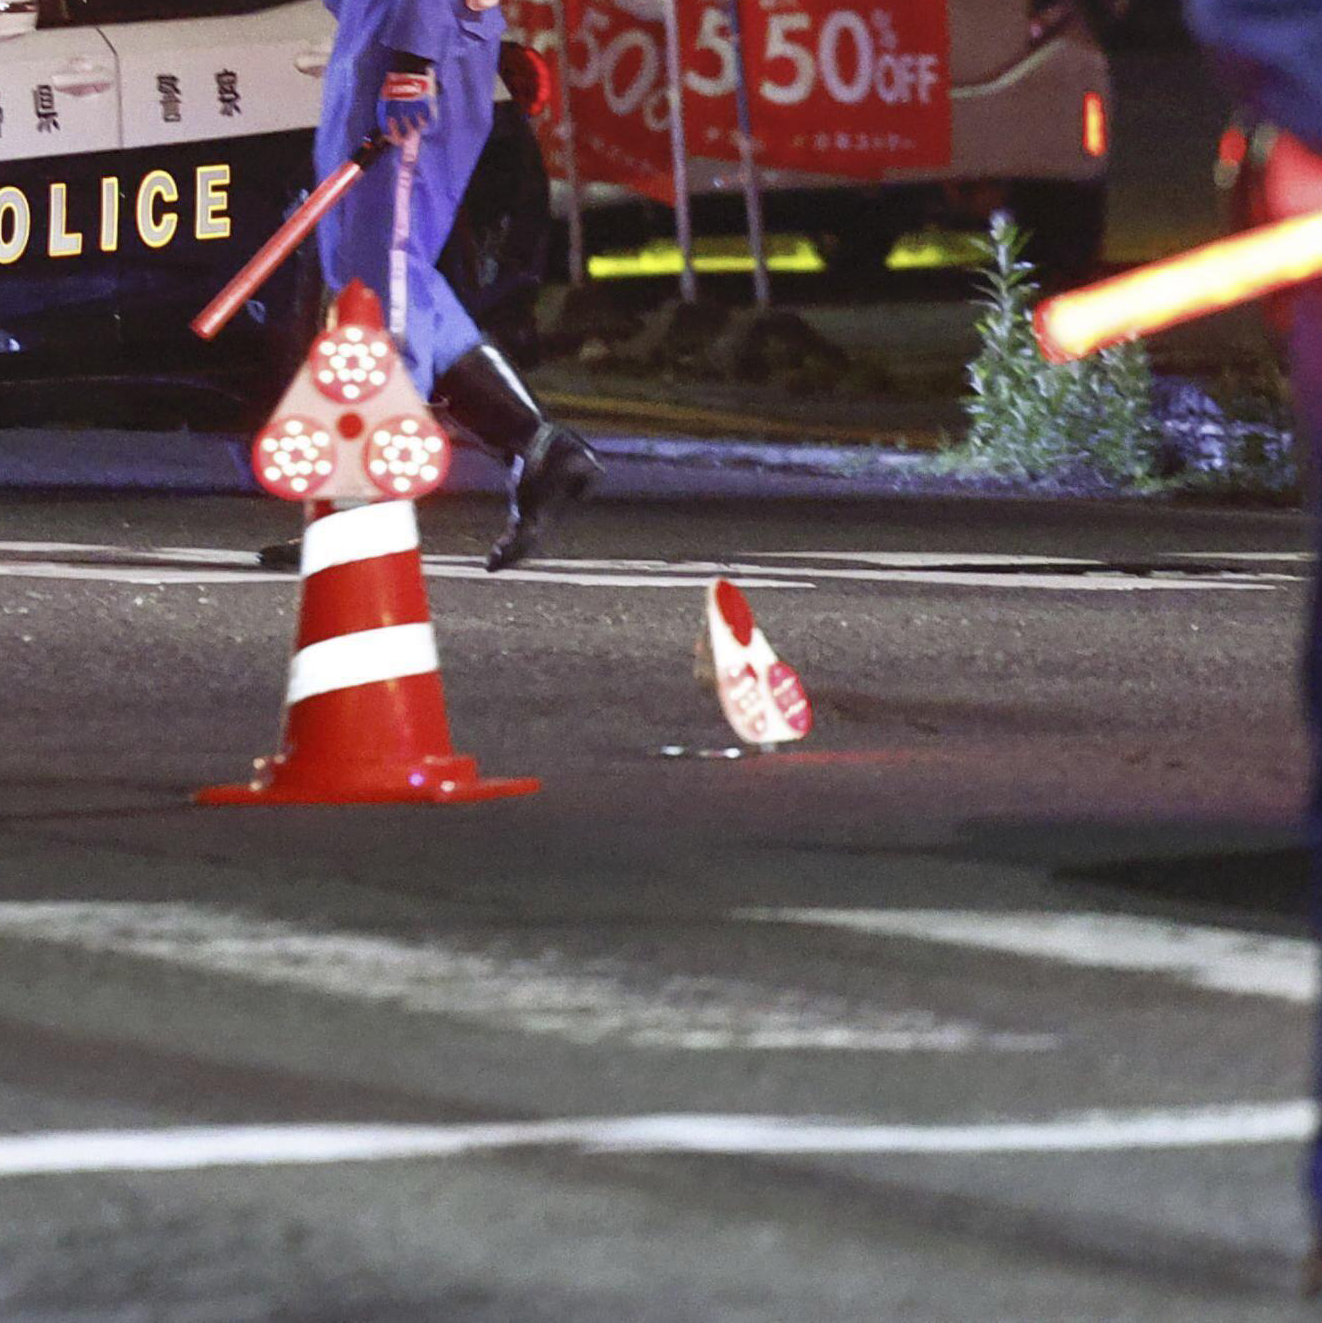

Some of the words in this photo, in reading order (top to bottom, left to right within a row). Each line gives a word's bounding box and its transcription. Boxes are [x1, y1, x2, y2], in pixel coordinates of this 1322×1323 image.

[155, 67, 244, 125] 警察
[758, 8, 874, 106] 50
[876, 54, 939, 105] OFF
